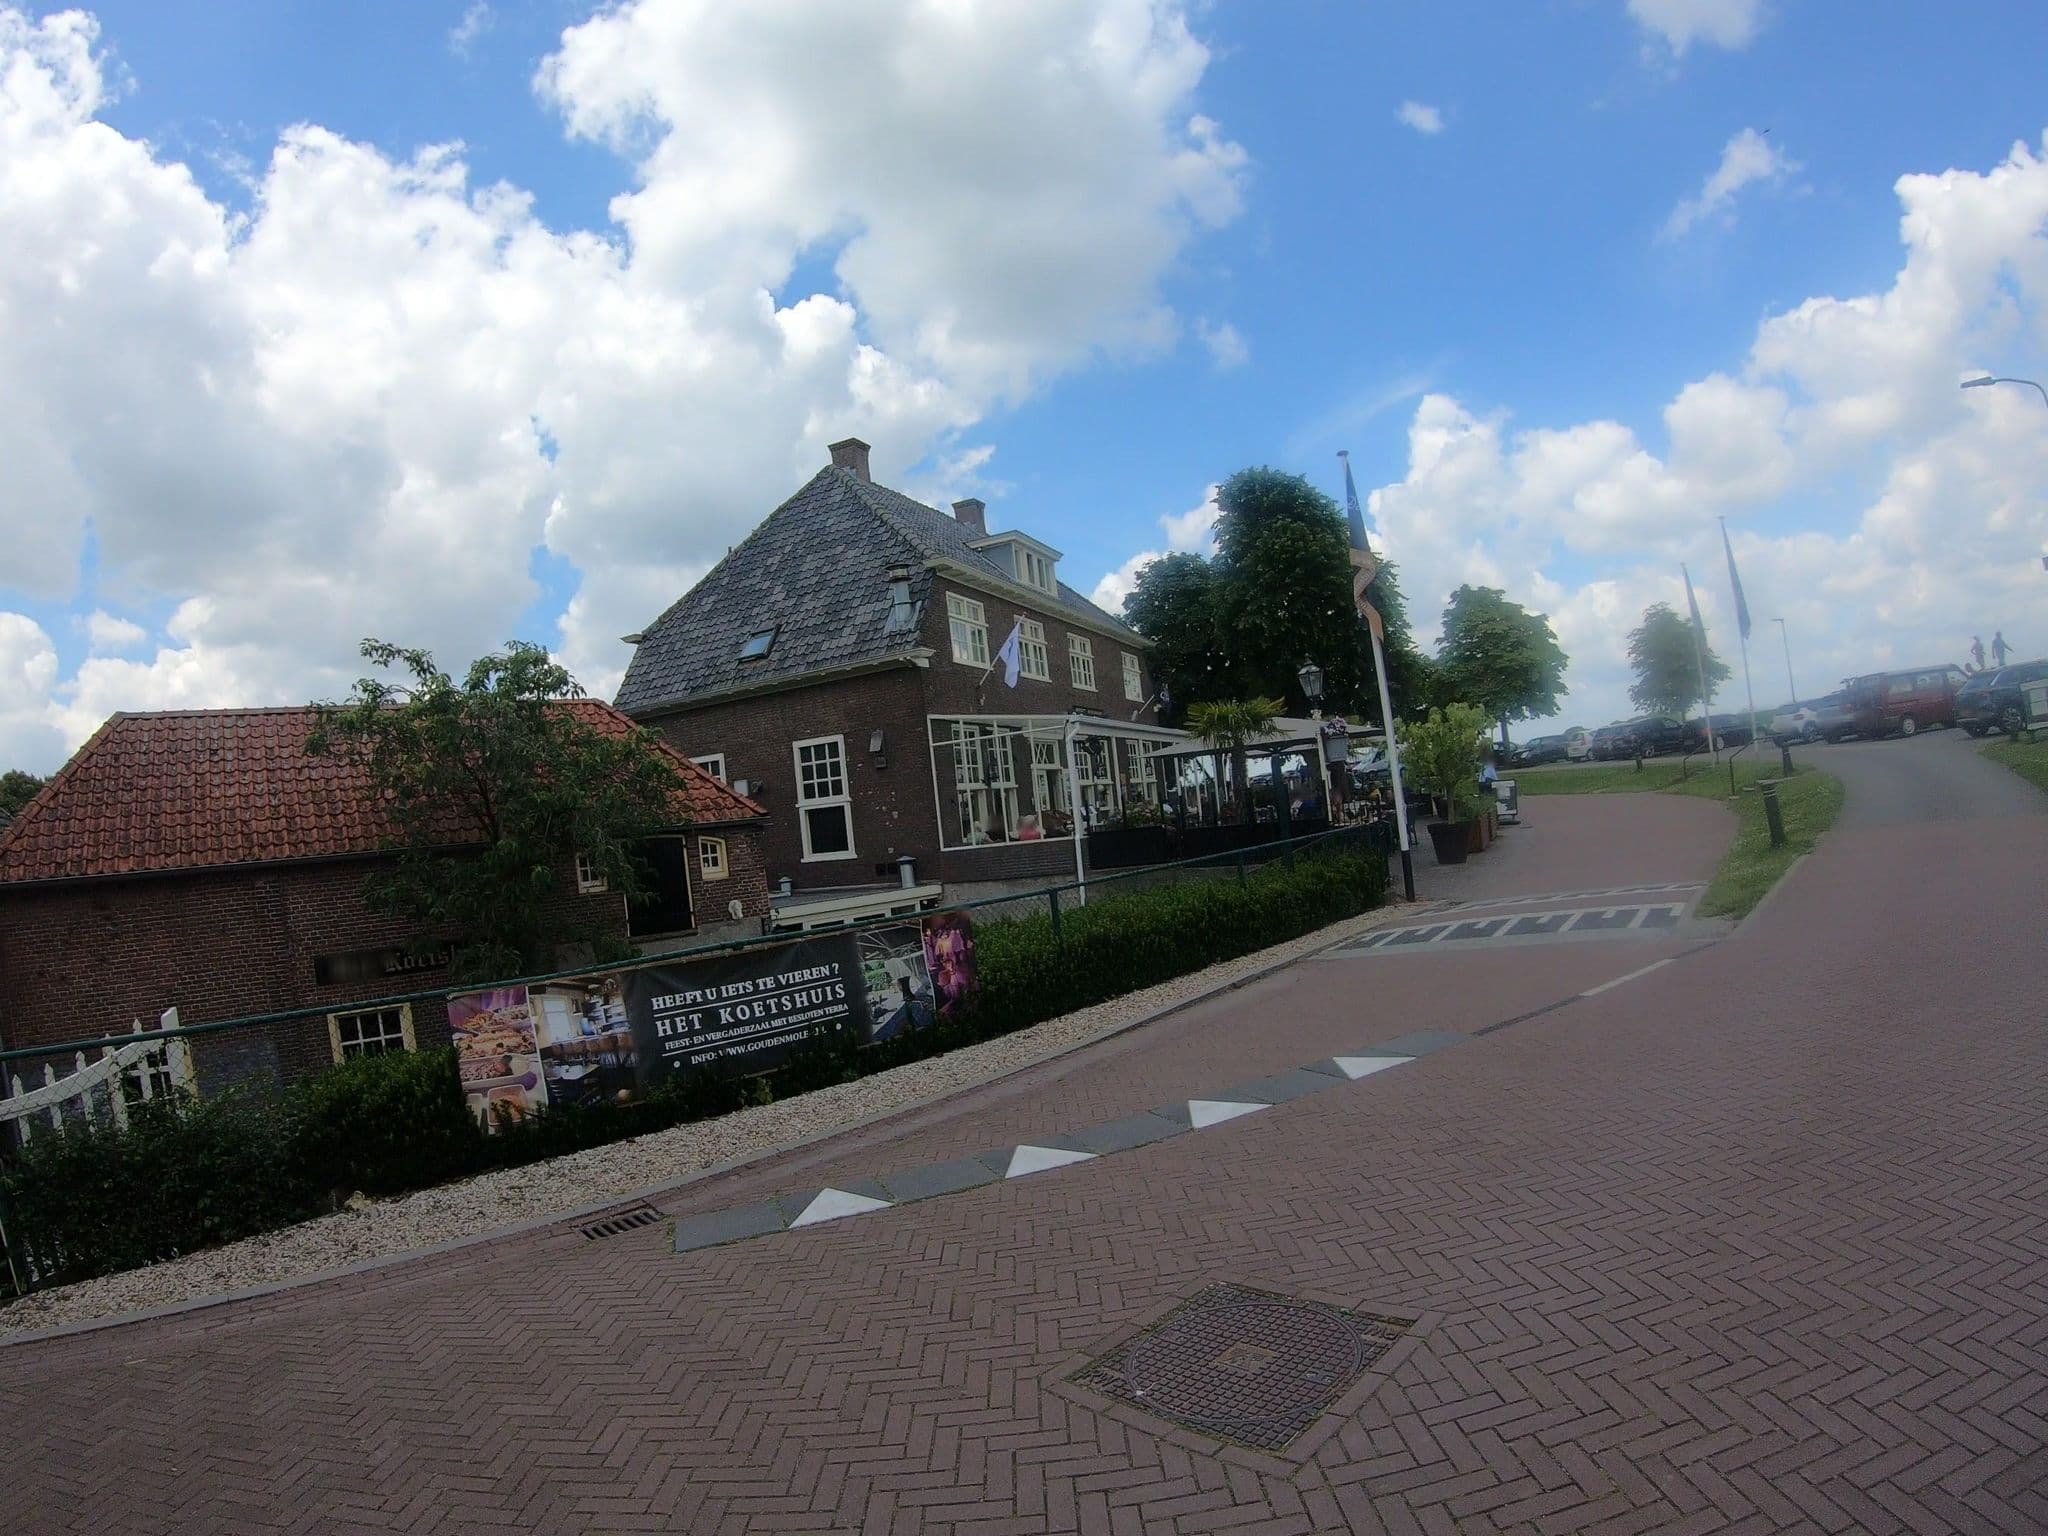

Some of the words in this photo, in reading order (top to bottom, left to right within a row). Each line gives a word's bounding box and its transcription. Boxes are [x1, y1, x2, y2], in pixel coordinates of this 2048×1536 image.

[651, 990, 703, 1010] HEEFT
[705, 988, 717, 1000] U
[720, 981, 753, 997] IETS
[755, 977, 775, 990] TE
[777, 965, 830, 985] VIEREN
[832, 963, 839, 974] ?
[655, 1013, 702, 1037] HET
[719, 984, 845, 1024] KOETSHUIS
[665, 1038, 692, 1050] FEEST-
[693, 1035, 705, 1044] EN
[705, 1021, 772, 1040] VERGADERZAAL
[771, 1018, 787, 1028] MET
[788, 1008, 823, 1024] BESLOTEN
[691, 1052, 717, 1064] INFO:
